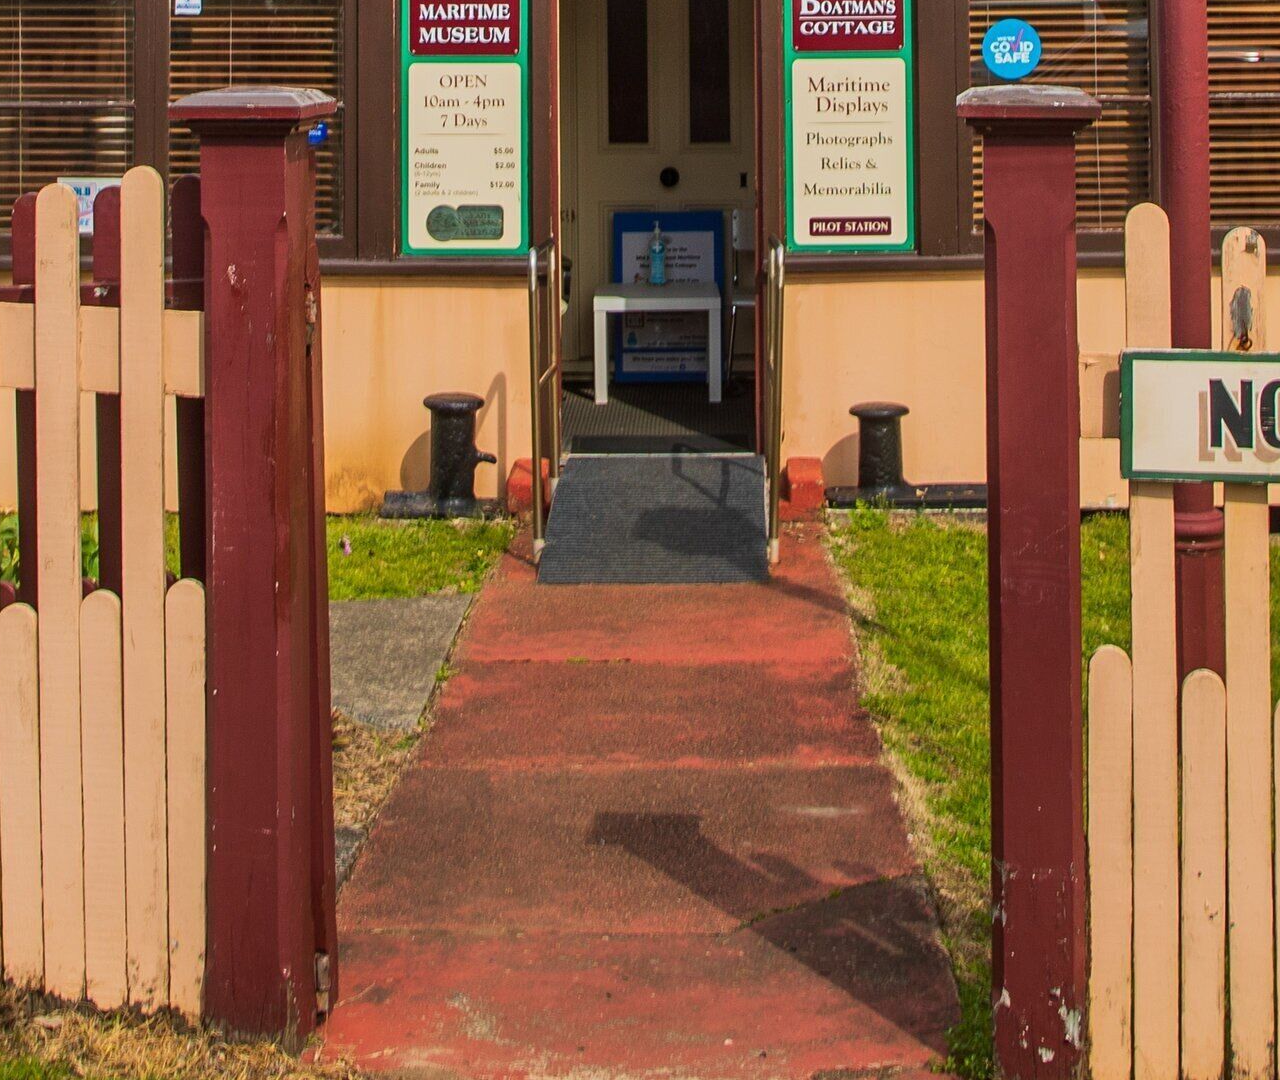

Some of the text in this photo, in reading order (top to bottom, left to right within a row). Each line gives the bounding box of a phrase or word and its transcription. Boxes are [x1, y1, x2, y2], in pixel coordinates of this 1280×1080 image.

[419, 4, 510, 20] MARITIME
[419, 27, 510, 43] MUSEUM
[800, 21, 896, 35] COTTAGE
[994, 52, 1030, 64] SAFE
[440, 74, 487, 88] OPEN
[808, 77, 891, 93] Maritime
[424, 95, 460, 108] 10am
[473, 94, 505, 110] 4pm
[817, 96, 888, 115] Displays
[440, 113, 488, 129] 7 Days
[806, 132, 893, 147] Photographs
[414, 146, 514, 155] Adults $5.00
[414, 161, 516, 169] Children $2.00
[821, 157, 878, 170] Relics &
[415, 181, 515, 190] Family $12.00
[804, 183, 892, 196] Memorabilia
[813, 221, 888, 232] PILOT STATION
